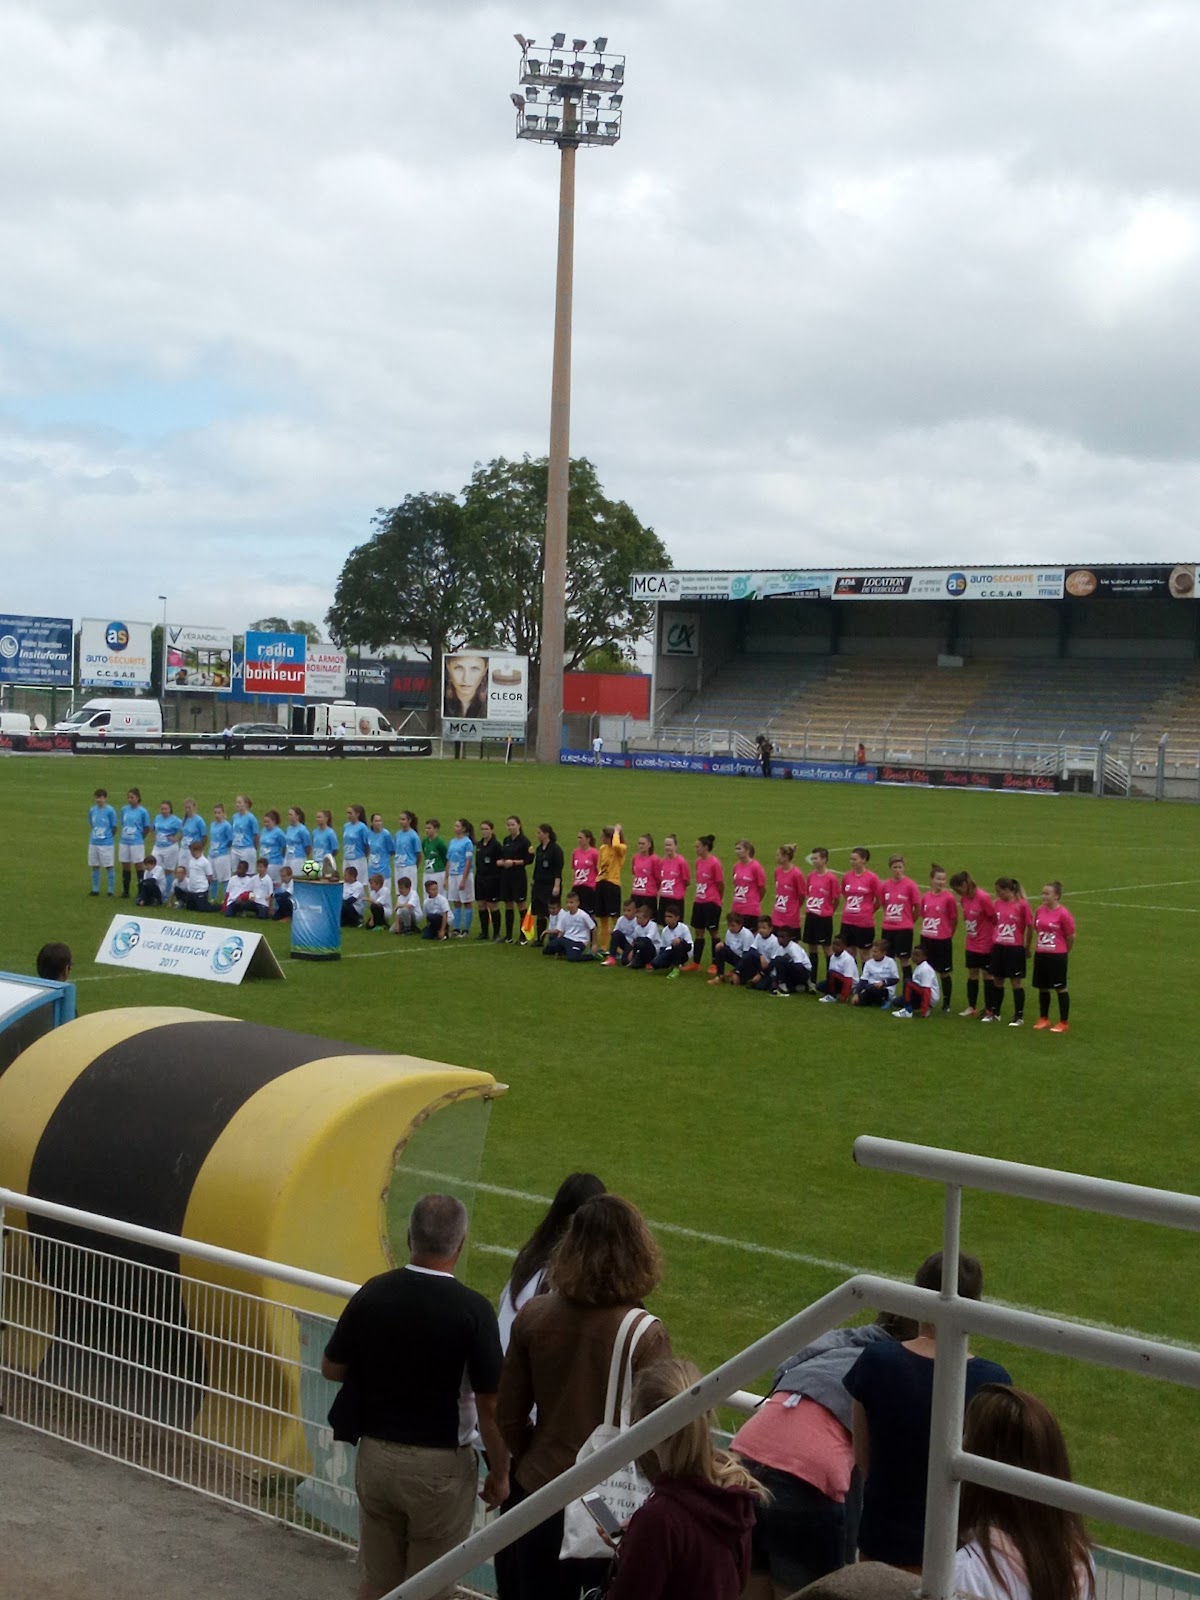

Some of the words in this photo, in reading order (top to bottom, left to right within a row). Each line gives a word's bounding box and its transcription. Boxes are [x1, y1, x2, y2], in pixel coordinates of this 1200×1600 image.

[634, 577, 667, 593] MCA
[863, 577, 906, 587] LOCATION
[107, 630, 128, 644] as
[19, 649, 68, 661] Insituform
[257, 642, 295, 657] radio
[246, 659, 305, 682] bonheur
[306, 664, 342, 674] BOBINAGE
[490, 692, 523, 701] CLEOR
[450, 723, 477, 733] MCA
[791, 766, 853, 779] ouest-france.fr
[161, 926, 206, 941] FINALISTES
[142, 940, 162, 951] LIGUE
[163, 943, 173, 953] DE
[173, 944, 210, 958] BRETAGNE
[159, 957, 180, 968] 2017
